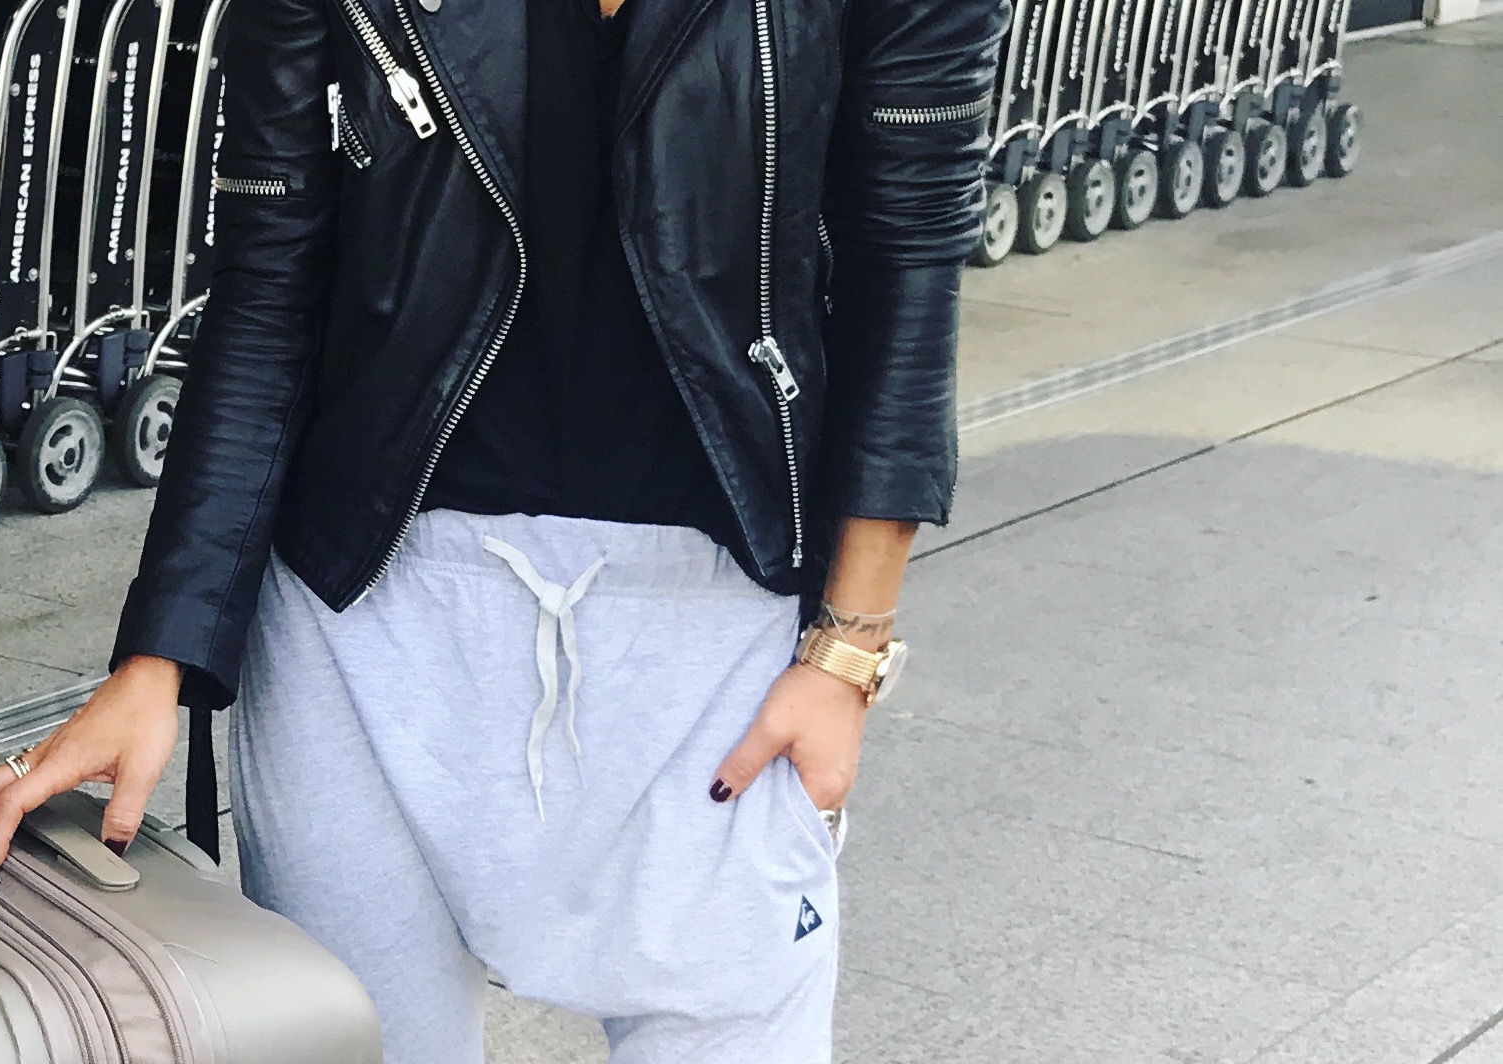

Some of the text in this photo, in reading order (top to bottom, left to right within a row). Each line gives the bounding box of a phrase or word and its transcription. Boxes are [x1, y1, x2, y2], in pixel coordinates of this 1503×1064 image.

[10, 54, 41, 283] AMERICAN EXPRESS
[108, 42, 139, 264] AMERICAN EXPRESS
